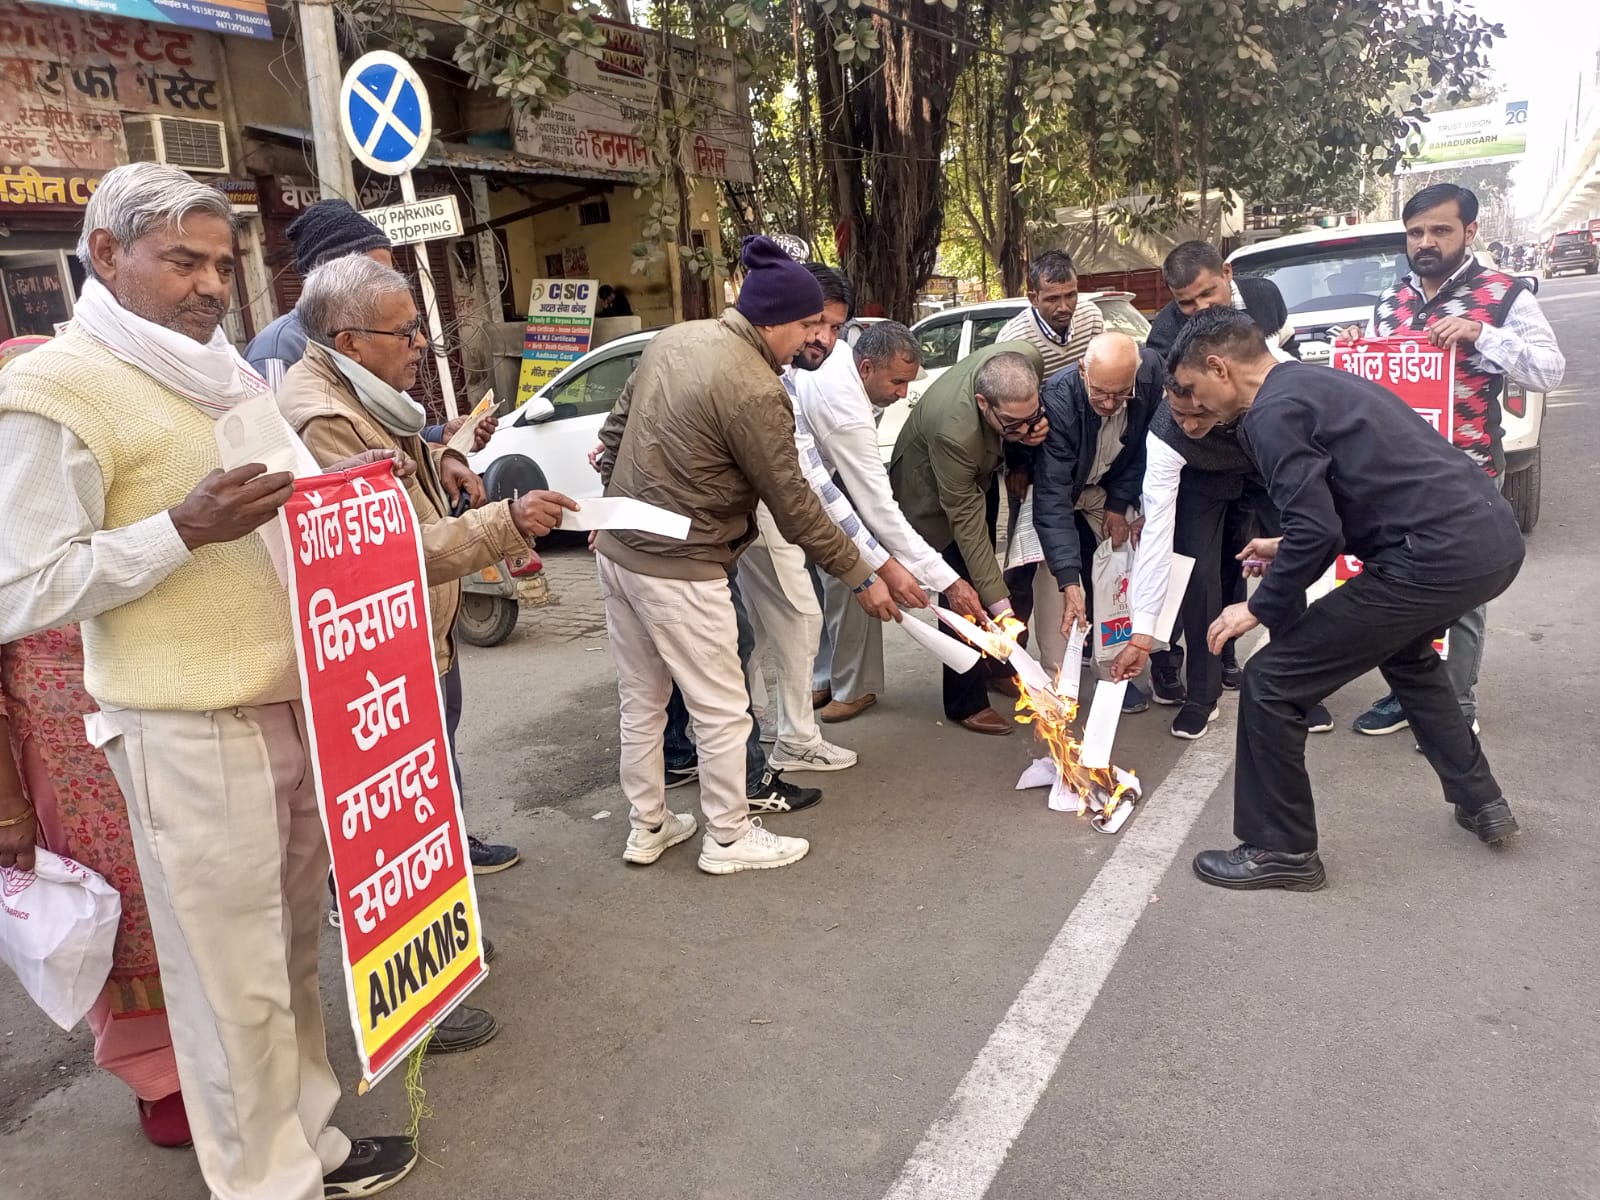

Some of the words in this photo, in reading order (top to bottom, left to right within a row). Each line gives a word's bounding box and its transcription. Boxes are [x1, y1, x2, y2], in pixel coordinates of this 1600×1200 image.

[1438, 122, 1462, 132] TRUST
[1464, 119, 1492, 129] VISION
[1505, 110, 1528, 125] 20
[1429, 135, 1498, 150] BAHADURGARH
[389, 203, 445, 224] PARKING
[390, 219, 452, 240] STOPPING
[539, 303, 556, 313] अटल
[557, 301, 570, 313] सेवा
[551, 334, 576, 342] Certificate
[560, 352, 574, 360] Card
[1341, 344, 1385, 381] ऑल
[296, 490, 343, 566] ऑल
[308, 580, 418, 673] किसान
[347, 670, 411, 752] खेत
[336, 738, 439, 840] मजदूर
[349, 821, 454, 935] संगठन
[368, 901, 471, 1032] AIKKMS
